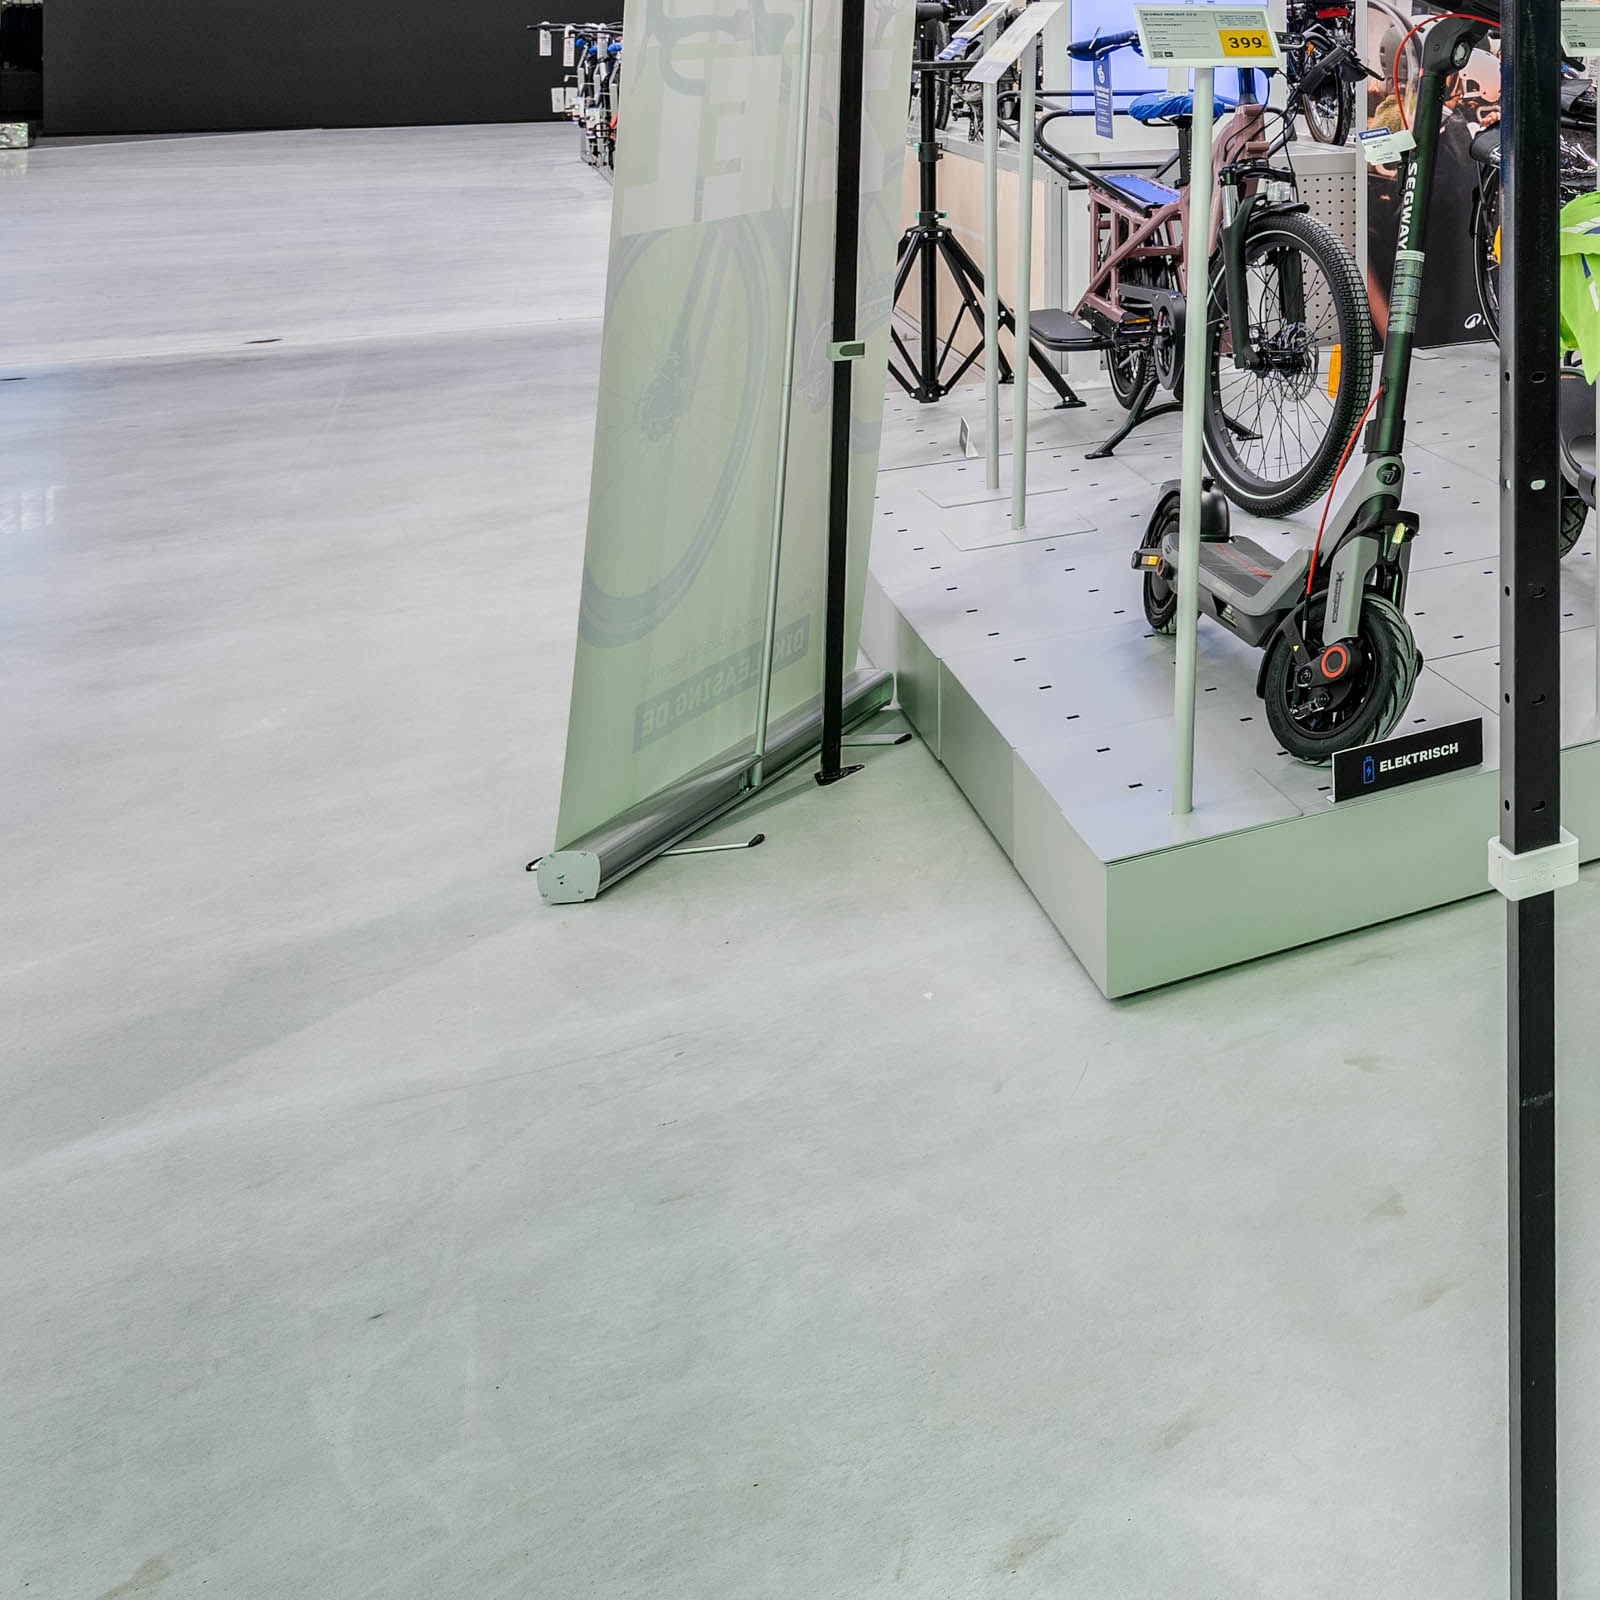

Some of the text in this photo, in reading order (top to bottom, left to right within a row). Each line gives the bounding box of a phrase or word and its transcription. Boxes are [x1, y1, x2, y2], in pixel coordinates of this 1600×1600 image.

[1228, 37, 1262, 49] 399
[1397, 162, 1418, 250] SEGWAY
[1379, 742, 1460, 774] ELEKTRISCH
